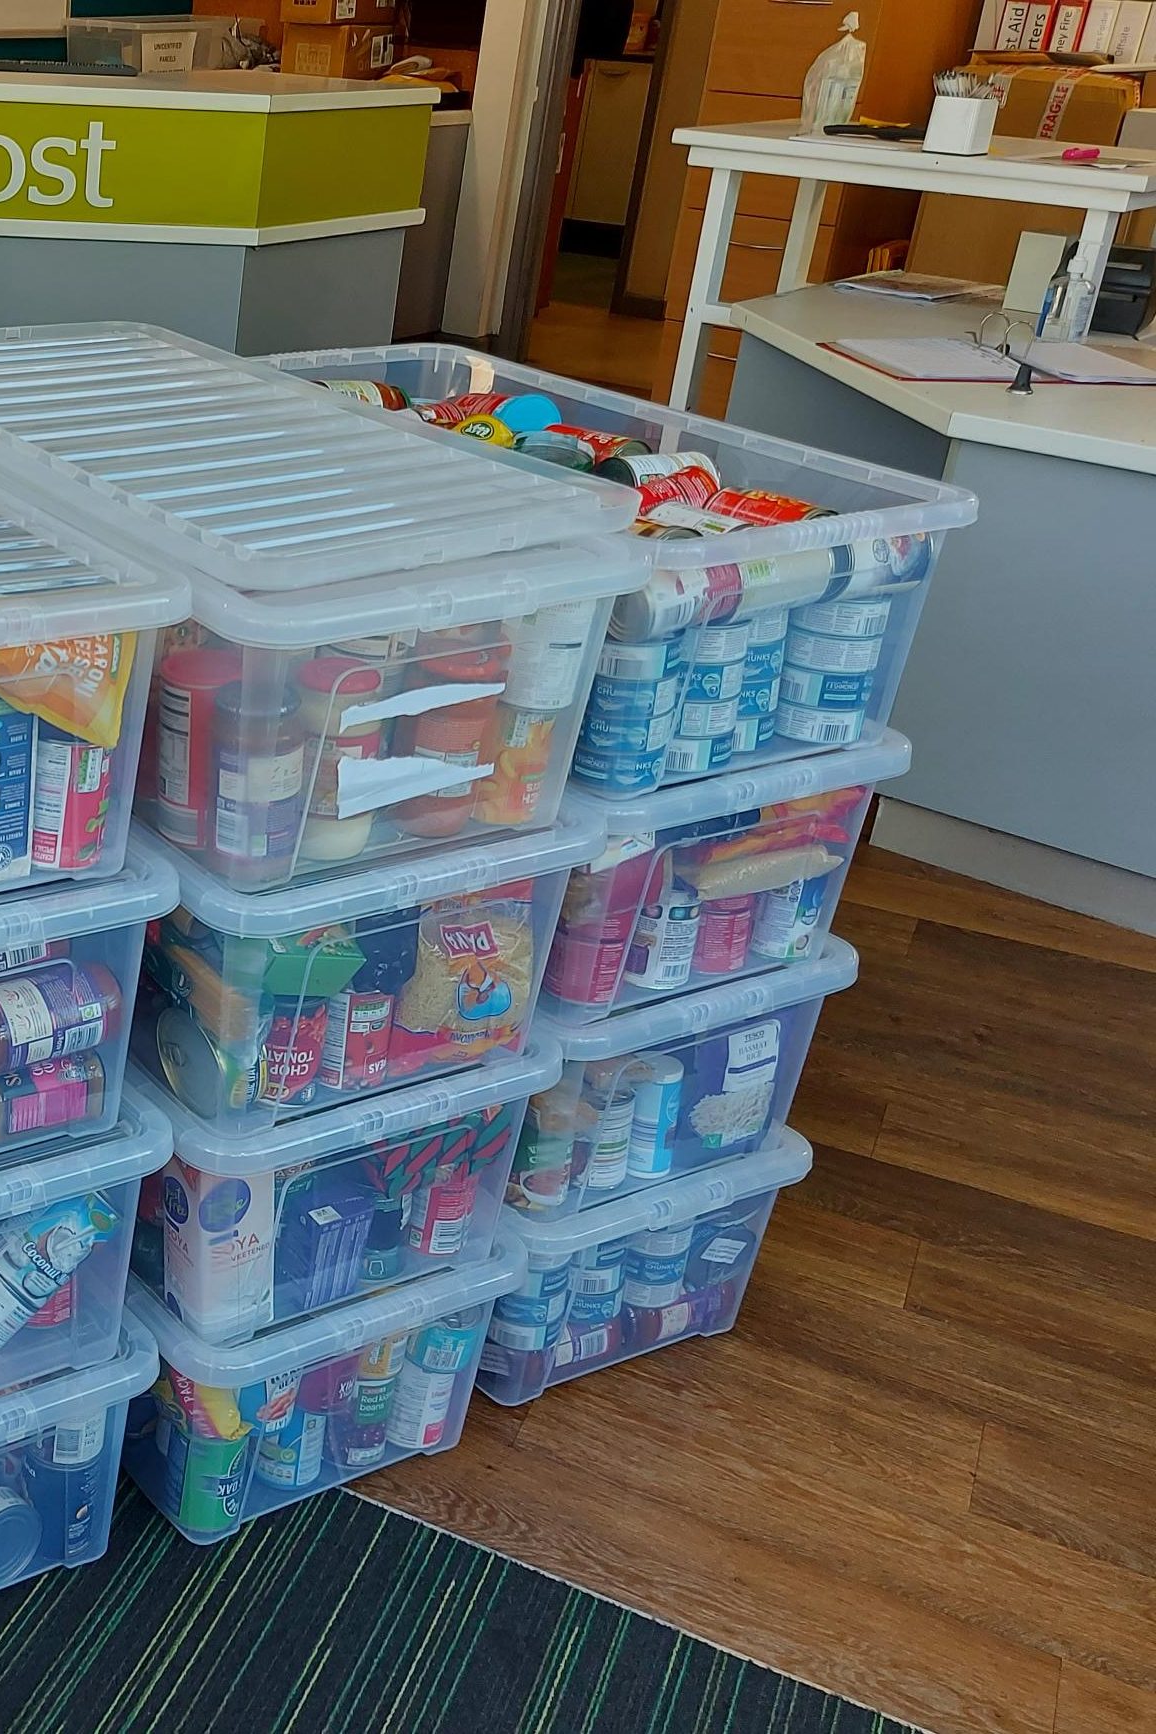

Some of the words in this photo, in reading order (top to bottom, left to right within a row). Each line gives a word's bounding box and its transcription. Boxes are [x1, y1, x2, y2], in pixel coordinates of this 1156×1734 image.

[1008, 8, 1025, 33] Aid
[1060, 11, 1073, 31] Fire
[153, 41, 182, 51] UNIDENTIFIED
[1115, 26, 1131, 56] Offsite
[1040, 85, 1069, 139] FRAGILE
[744, 1030, 764, 1042] TESCO
[22, 1241, 61, 1283] Coconut
[359, 1403, 385, 1412] beans
[360, 1394, 378, 1403] Red
